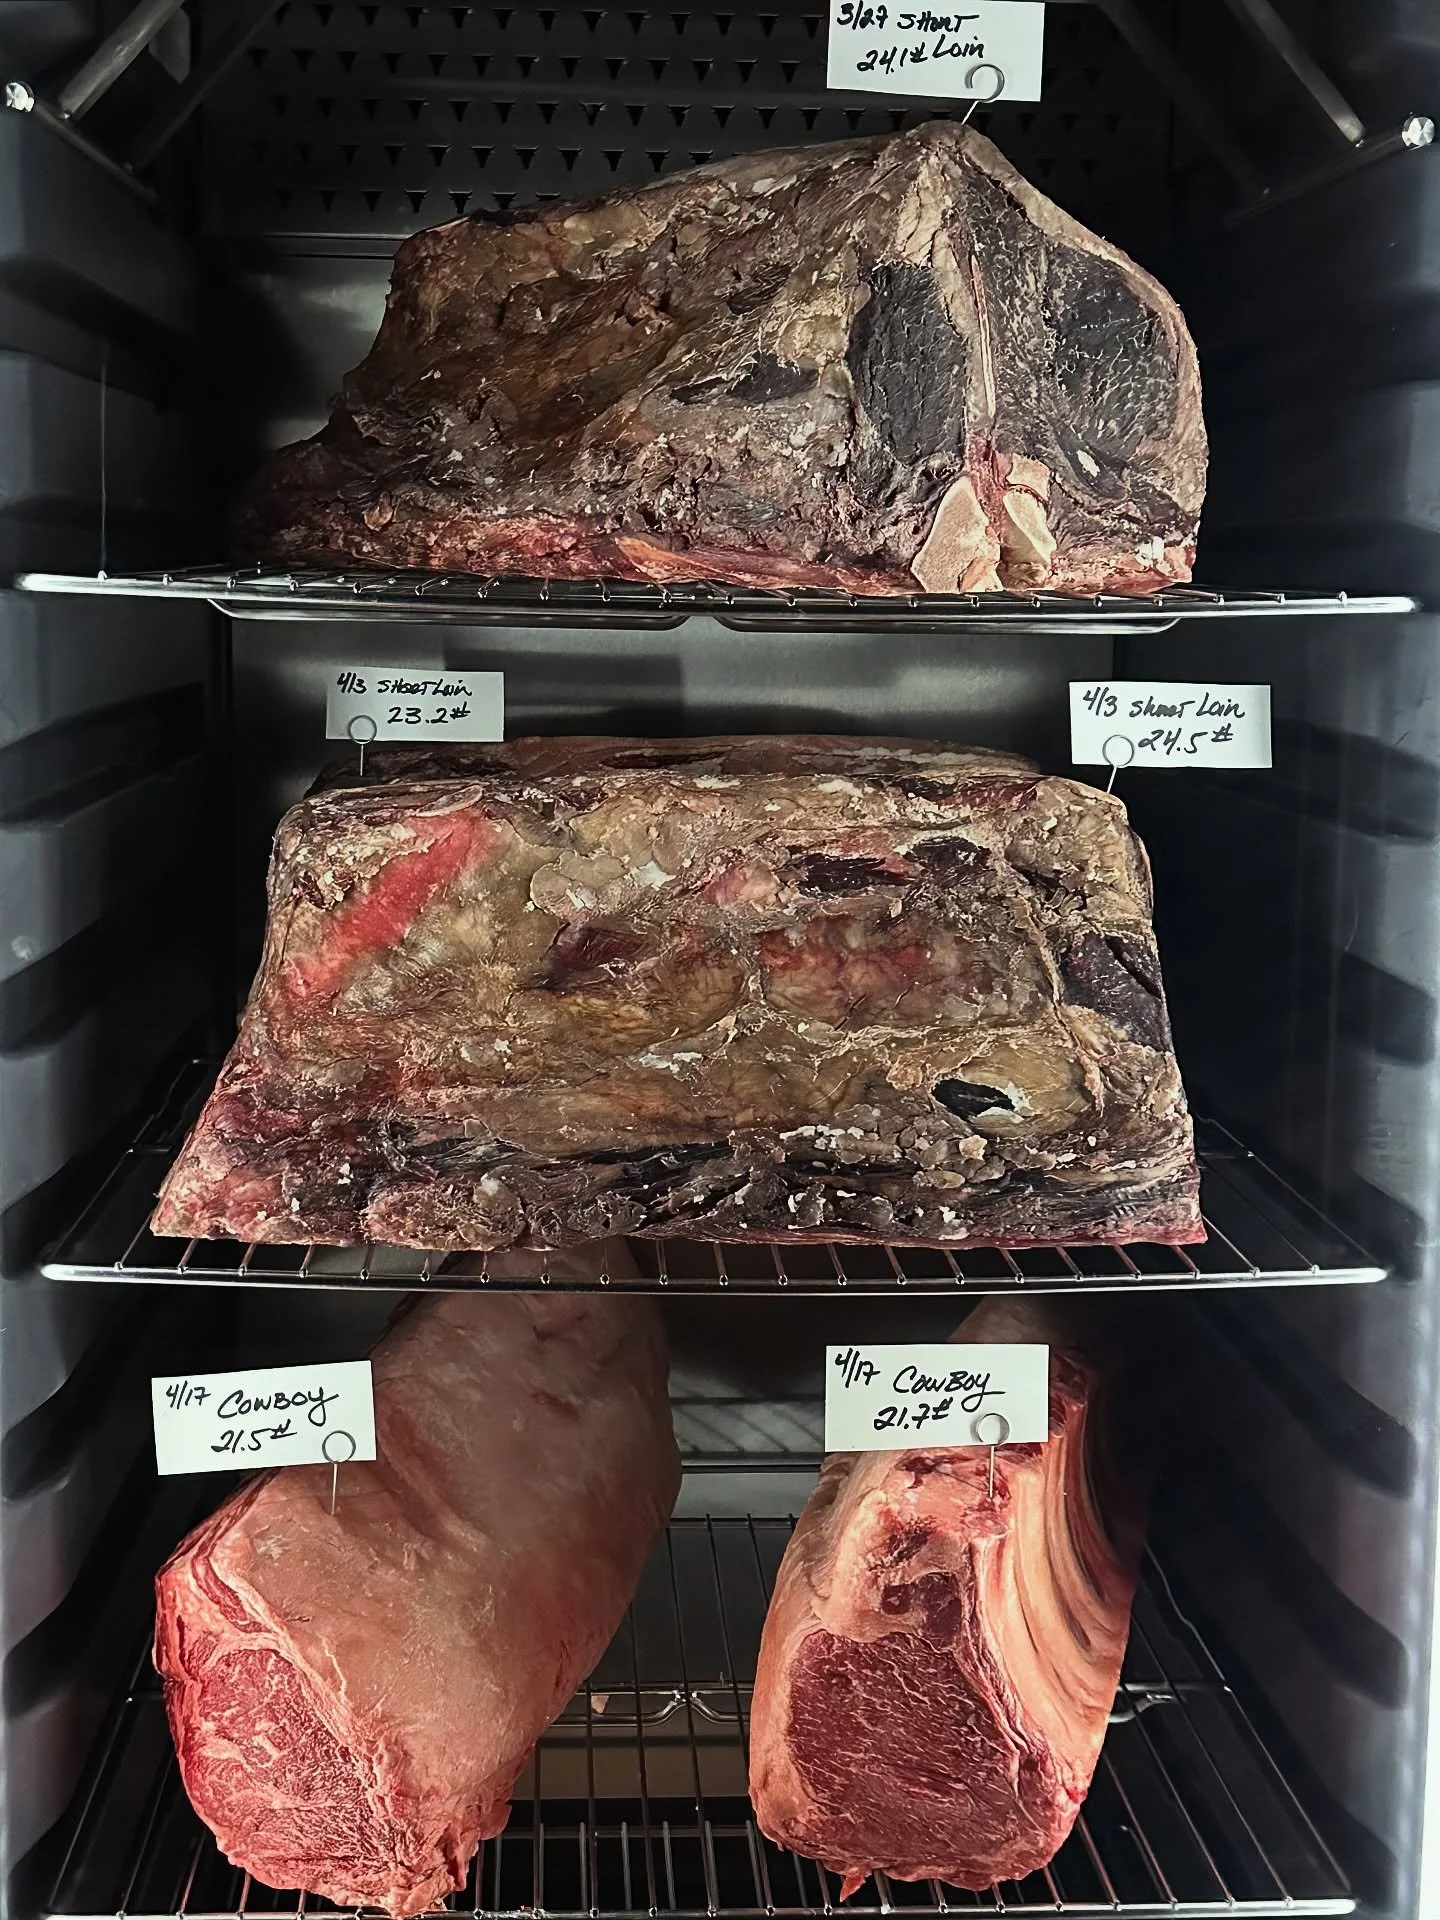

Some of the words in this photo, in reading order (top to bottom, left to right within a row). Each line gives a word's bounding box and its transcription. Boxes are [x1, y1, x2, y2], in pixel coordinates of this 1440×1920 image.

[836, 0, 889, 31] 3/27
[336, 671, 367, 694] 4/3
[1082, 686, 1118, 717] 4/3
[834, 1347, 881, 1389] 4/17
[165, 1380, 212, 1410] 4/17
